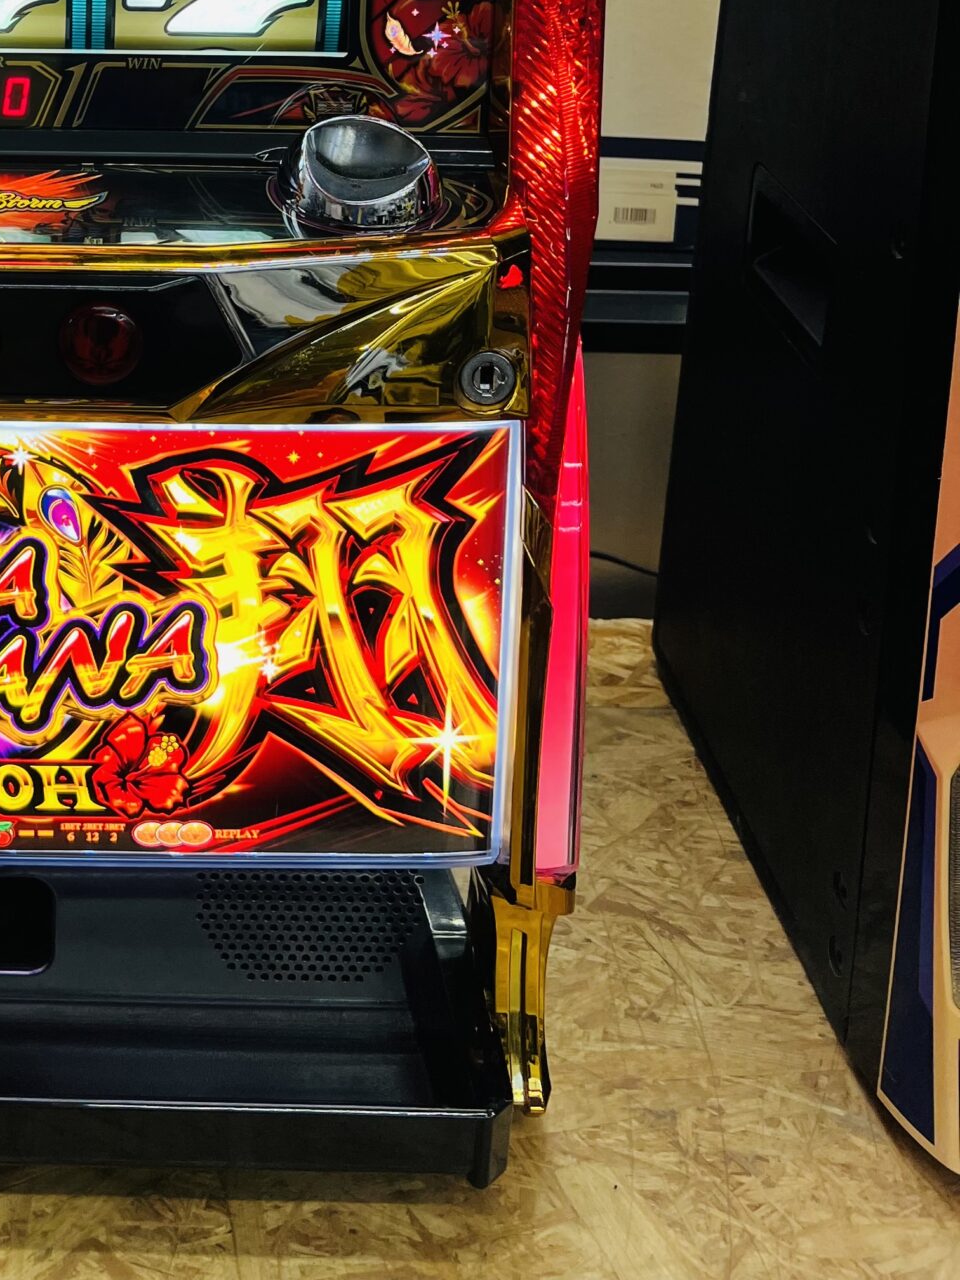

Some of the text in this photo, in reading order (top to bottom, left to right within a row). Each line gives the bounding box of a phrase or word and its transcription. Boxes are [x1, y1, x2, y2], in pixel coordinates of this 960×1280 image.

[127, 57, 162, 70] WIN
[1, 77, 31, 117] 0
[66, 832, 118, 841] 6 12 2
[214, 829, 261, 839] REPLAY
